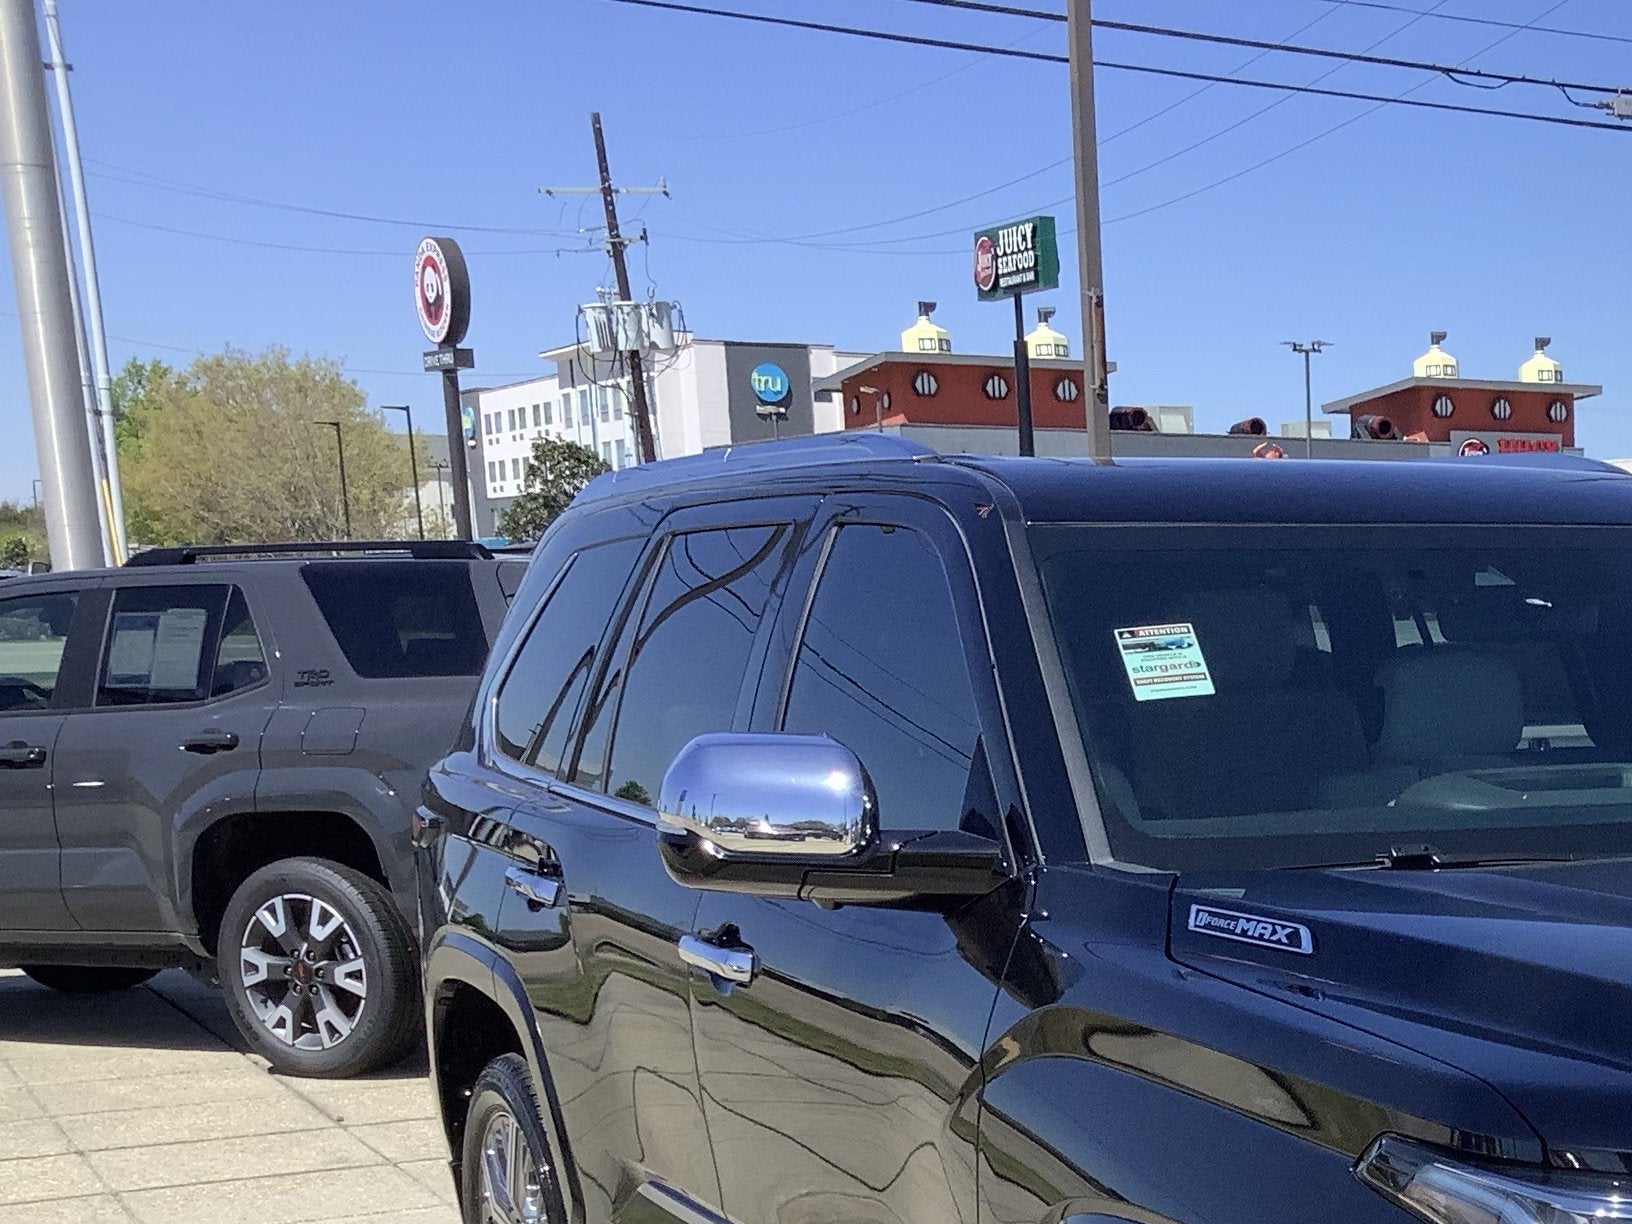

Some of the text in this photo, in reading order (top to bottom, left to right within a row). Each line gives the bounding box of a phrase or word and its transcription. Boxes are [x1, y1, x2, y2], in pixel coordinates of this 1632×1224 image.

[996, 222, 1033, 256] JUICY
[425, 241, 448, 282] EXPRESS
[997, 250, 1035, 274] SEAFOOD
[751, 369, 781, 392] tru
[1138, 626, 1189, 638] ATTENTION
[1234, 918, 1296, 944] MAX
